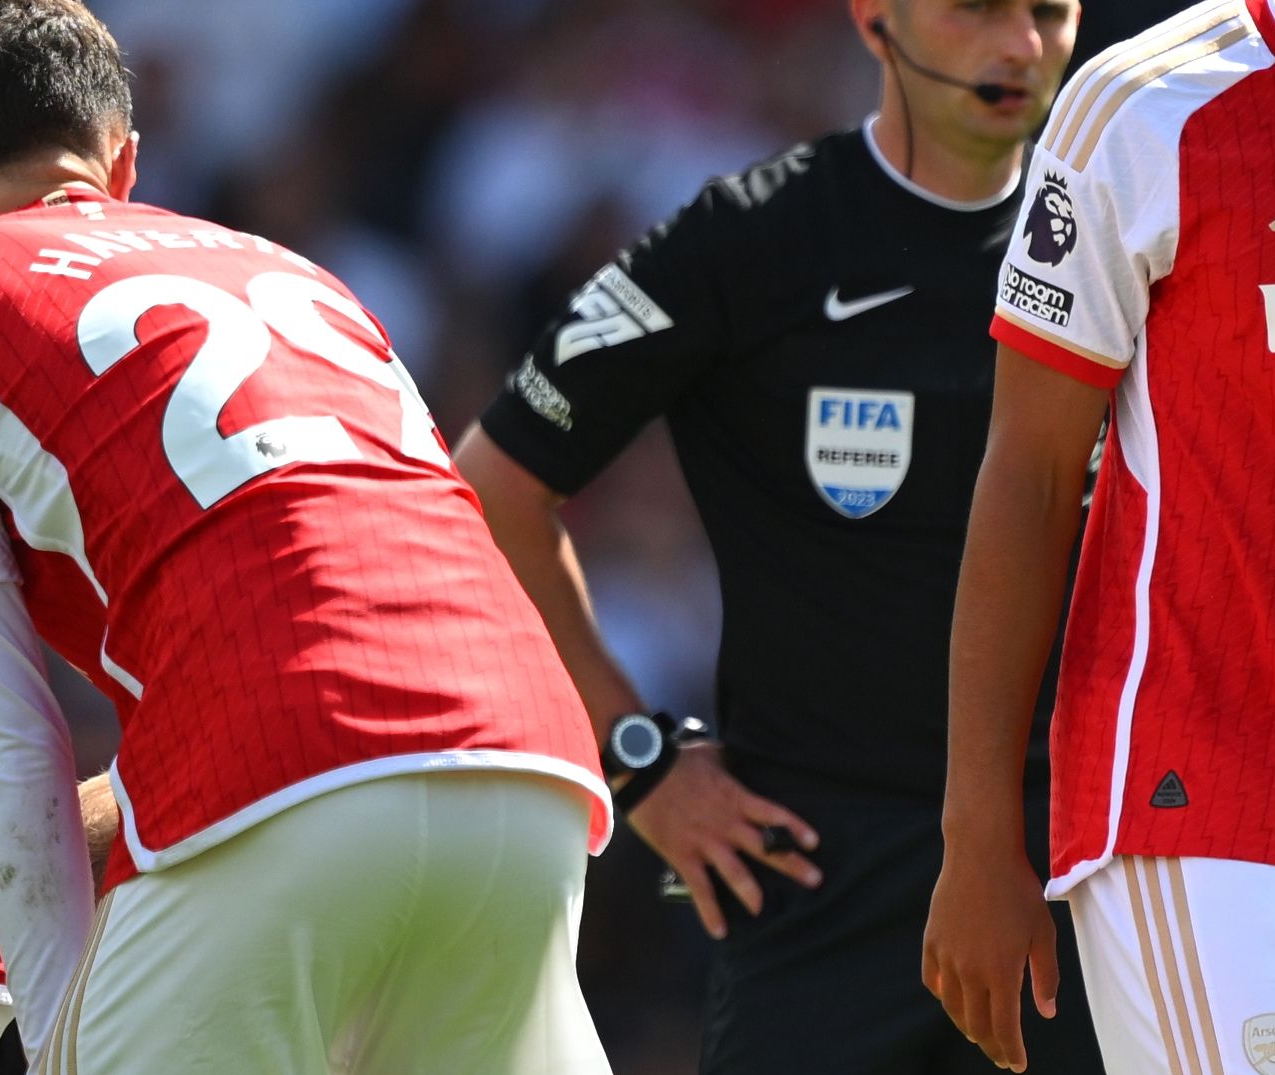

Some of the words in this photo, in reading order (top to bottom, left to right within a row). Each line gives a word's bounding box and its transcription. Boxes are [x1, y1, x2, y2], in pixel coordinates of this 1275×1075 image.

[1019, 276, 1065, 308] room
[1013, 290, 1069, 327] racism
[77, 271, 451, 511] 29
[820, 399, 902, 431] FIFA
[817, 448, 901, 468] REFEREE
